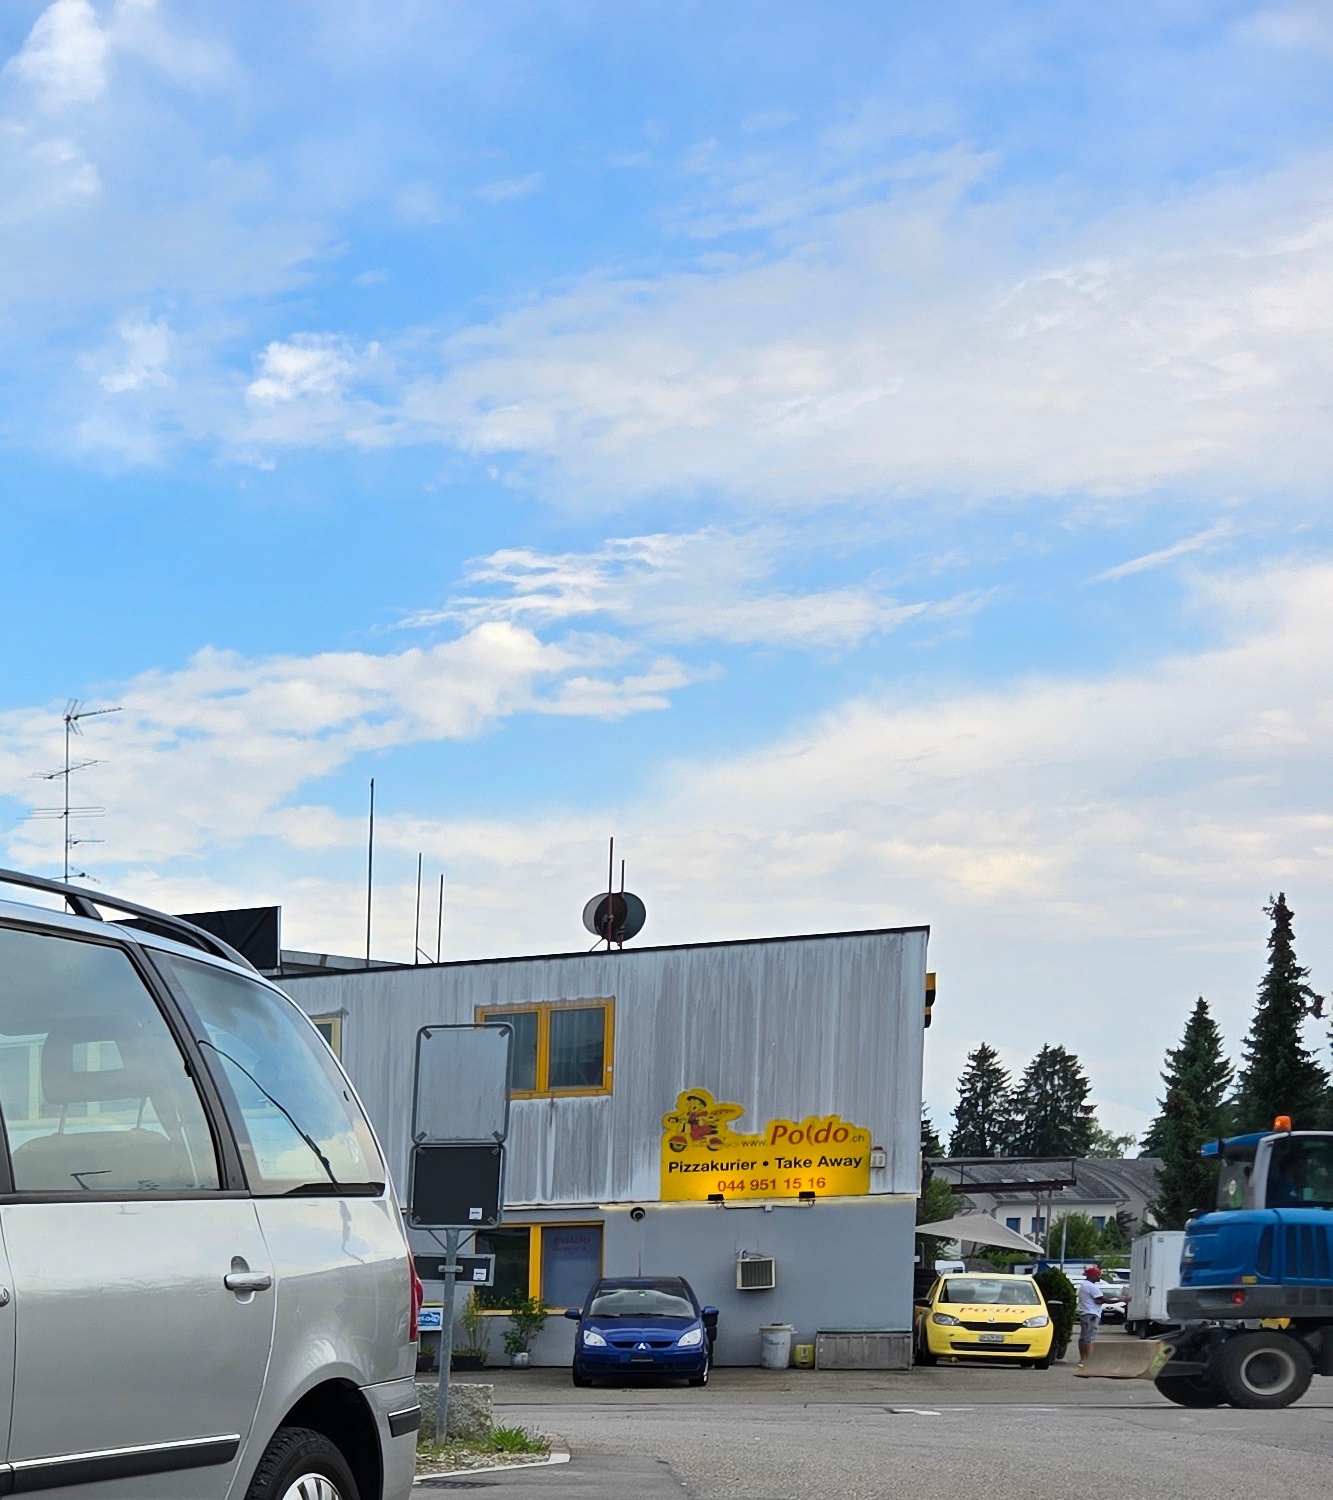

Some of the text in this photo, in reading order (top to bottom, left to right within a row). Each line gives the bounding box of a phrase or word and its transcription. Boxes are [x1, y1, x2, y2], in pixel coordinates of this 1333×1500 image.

[668, 1155, 863, 1174] Pizzakurier Take Away
[718, 1177, 826, 1192] 044 951 15 16
